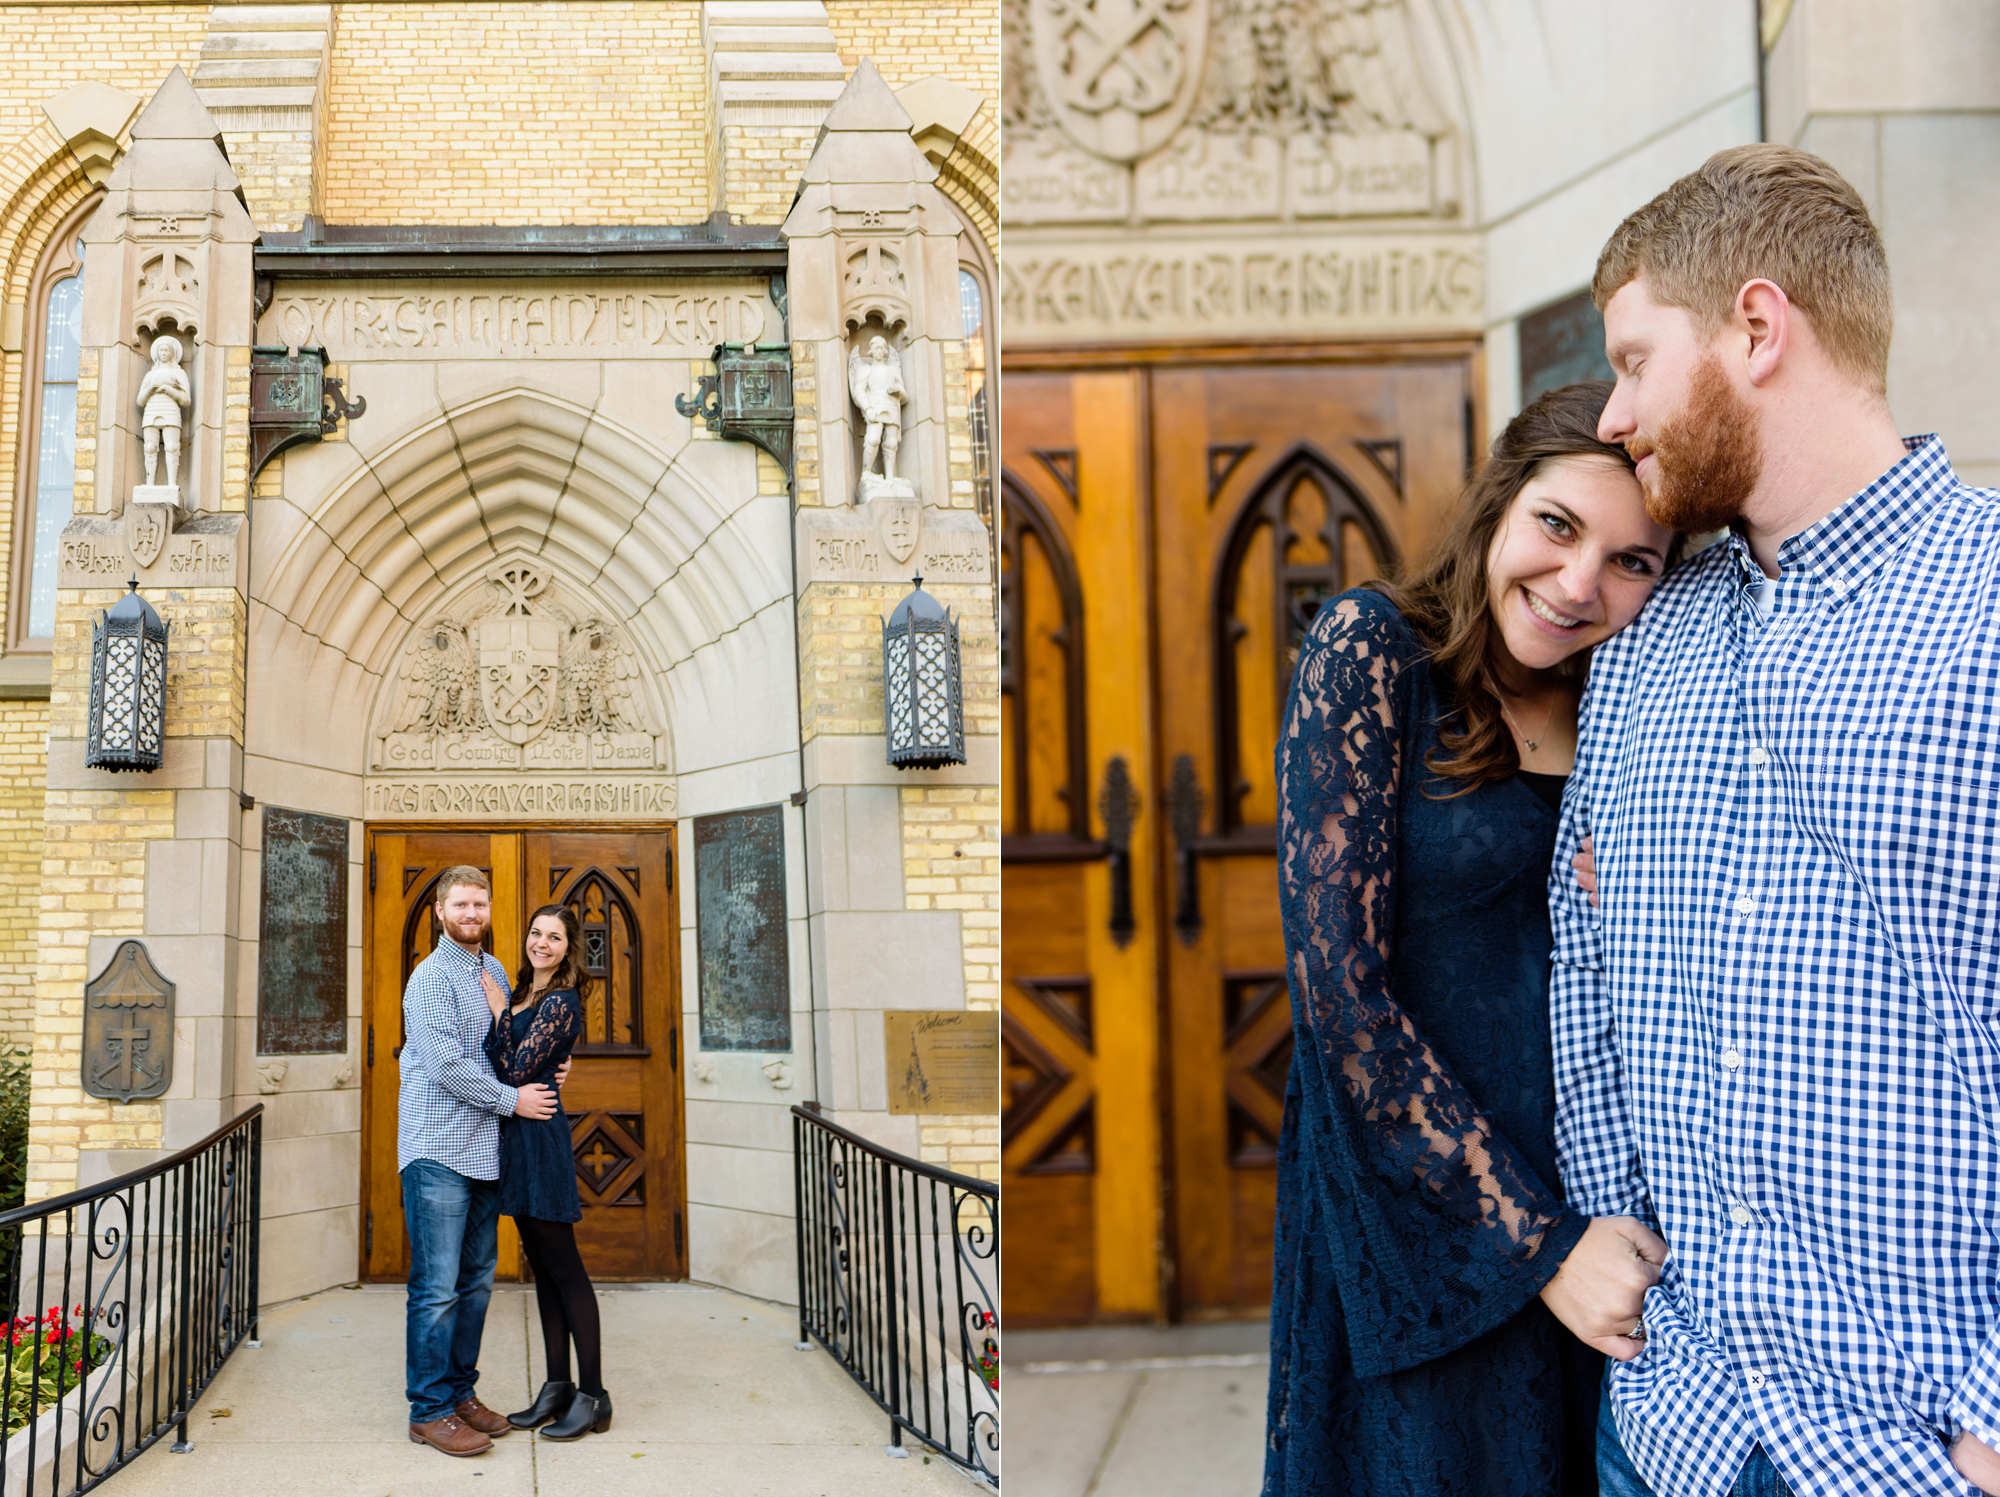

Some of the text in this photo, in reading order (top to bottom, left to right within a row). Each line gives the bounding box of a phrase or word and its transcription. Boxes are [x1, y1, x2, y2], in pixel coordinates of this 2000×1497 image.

[389, 742, 652, 764] God Country Notre Dame
[916, 1013, 963, 1034] Welcome
